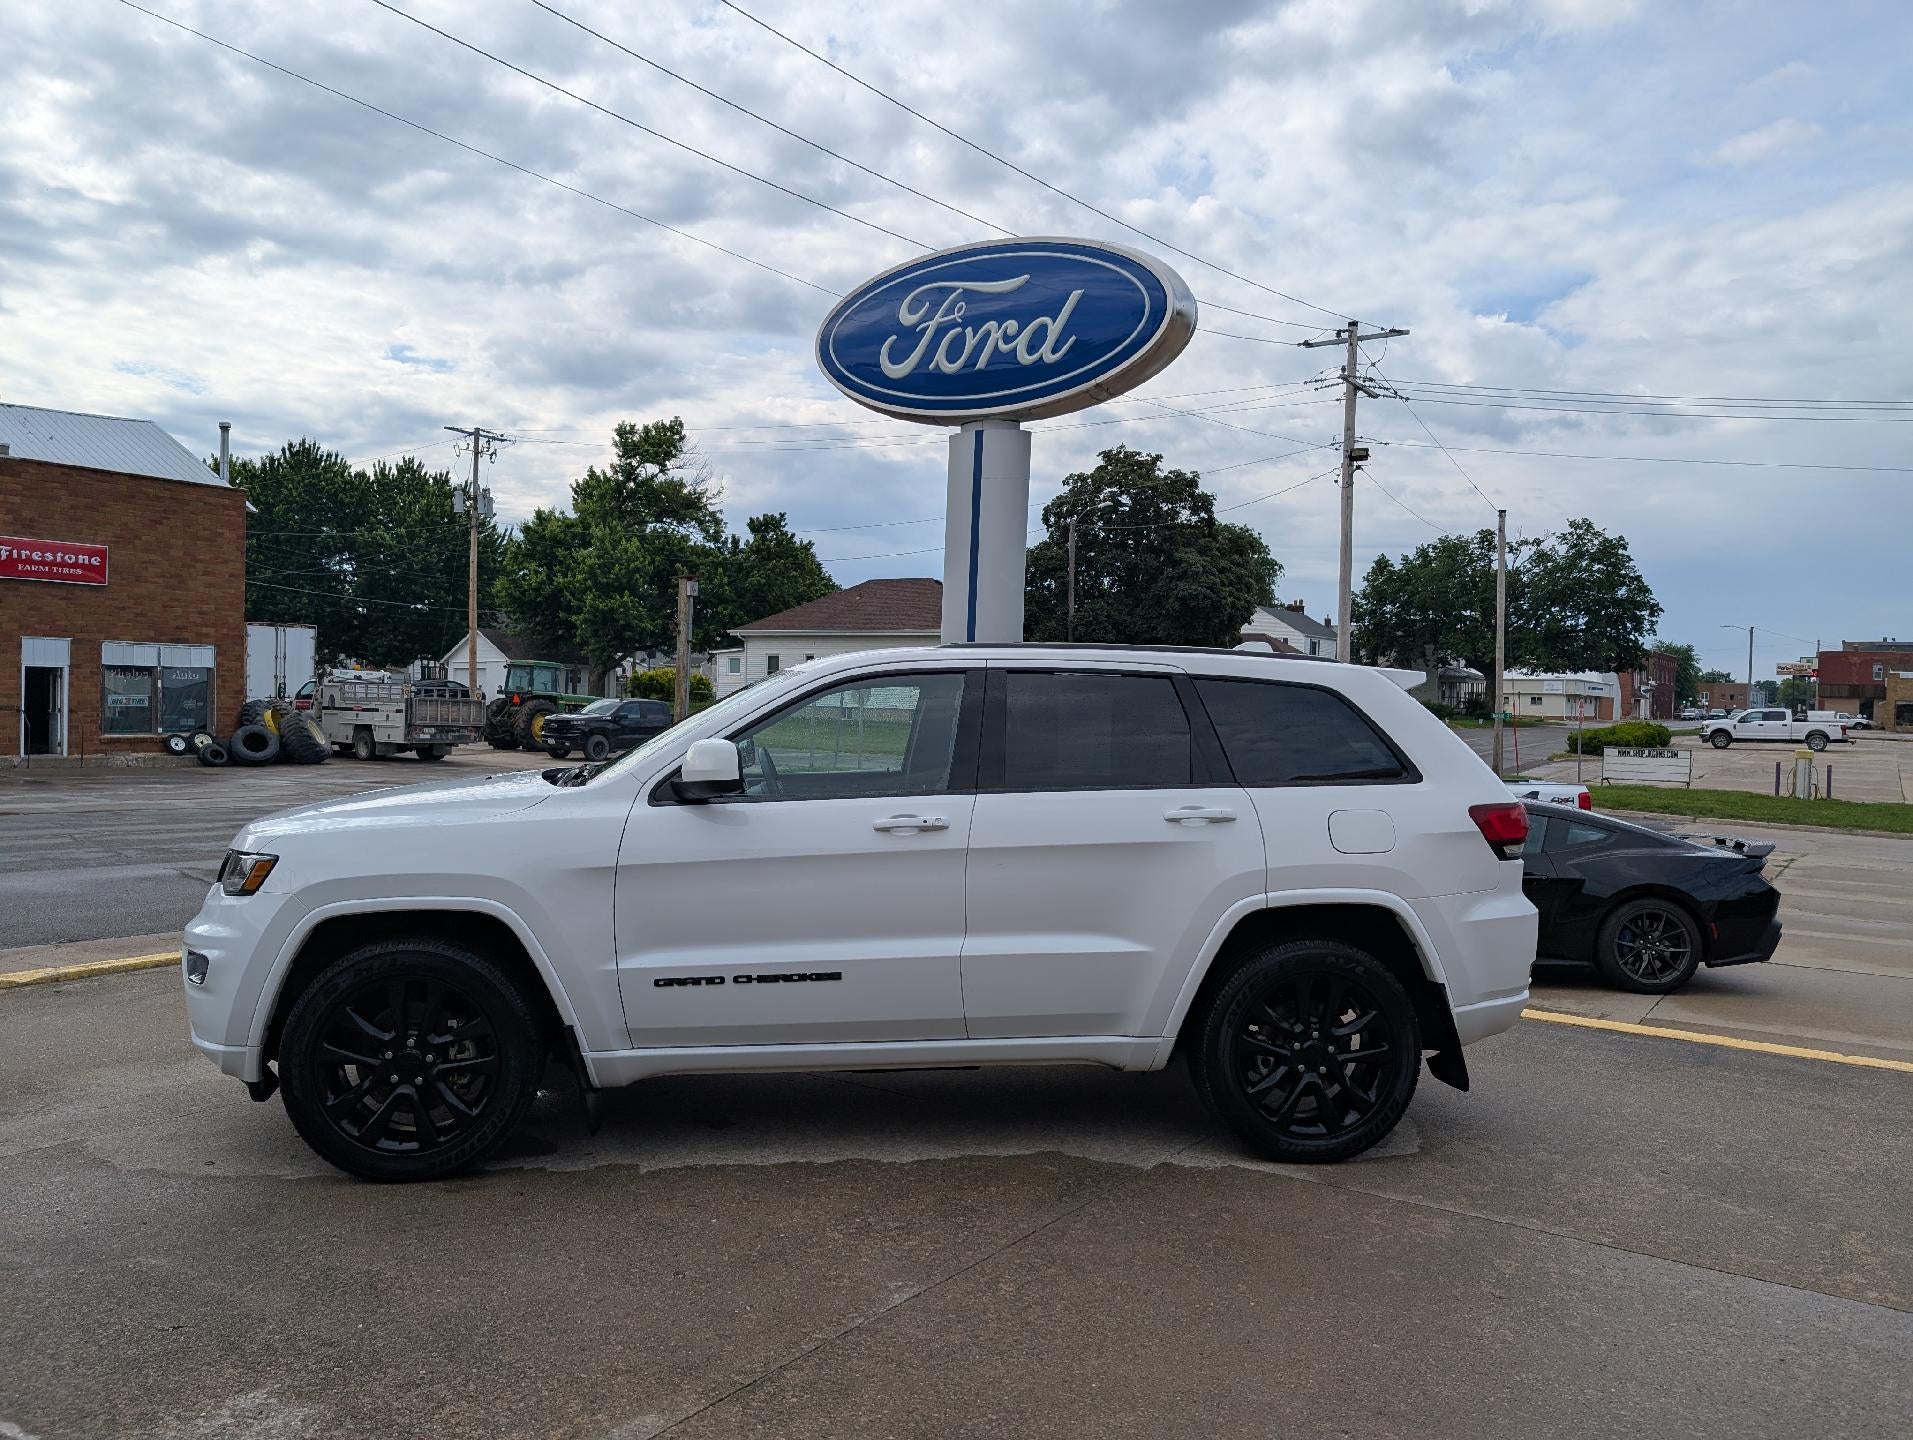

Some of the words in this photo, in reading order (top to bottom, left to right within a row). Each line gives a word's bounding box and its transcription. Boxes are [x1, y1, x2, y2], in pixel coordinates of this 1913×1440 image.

[880, 274, 1085, 379] Ford
[0, 545, 102, 566] Firestone
[17, 563, 49, 573] FARM
[52, 566, 83, 575] TIRES
[653, 976, 726, 988] GRAND
[732, 971, 843, 984] CHEROKEE
